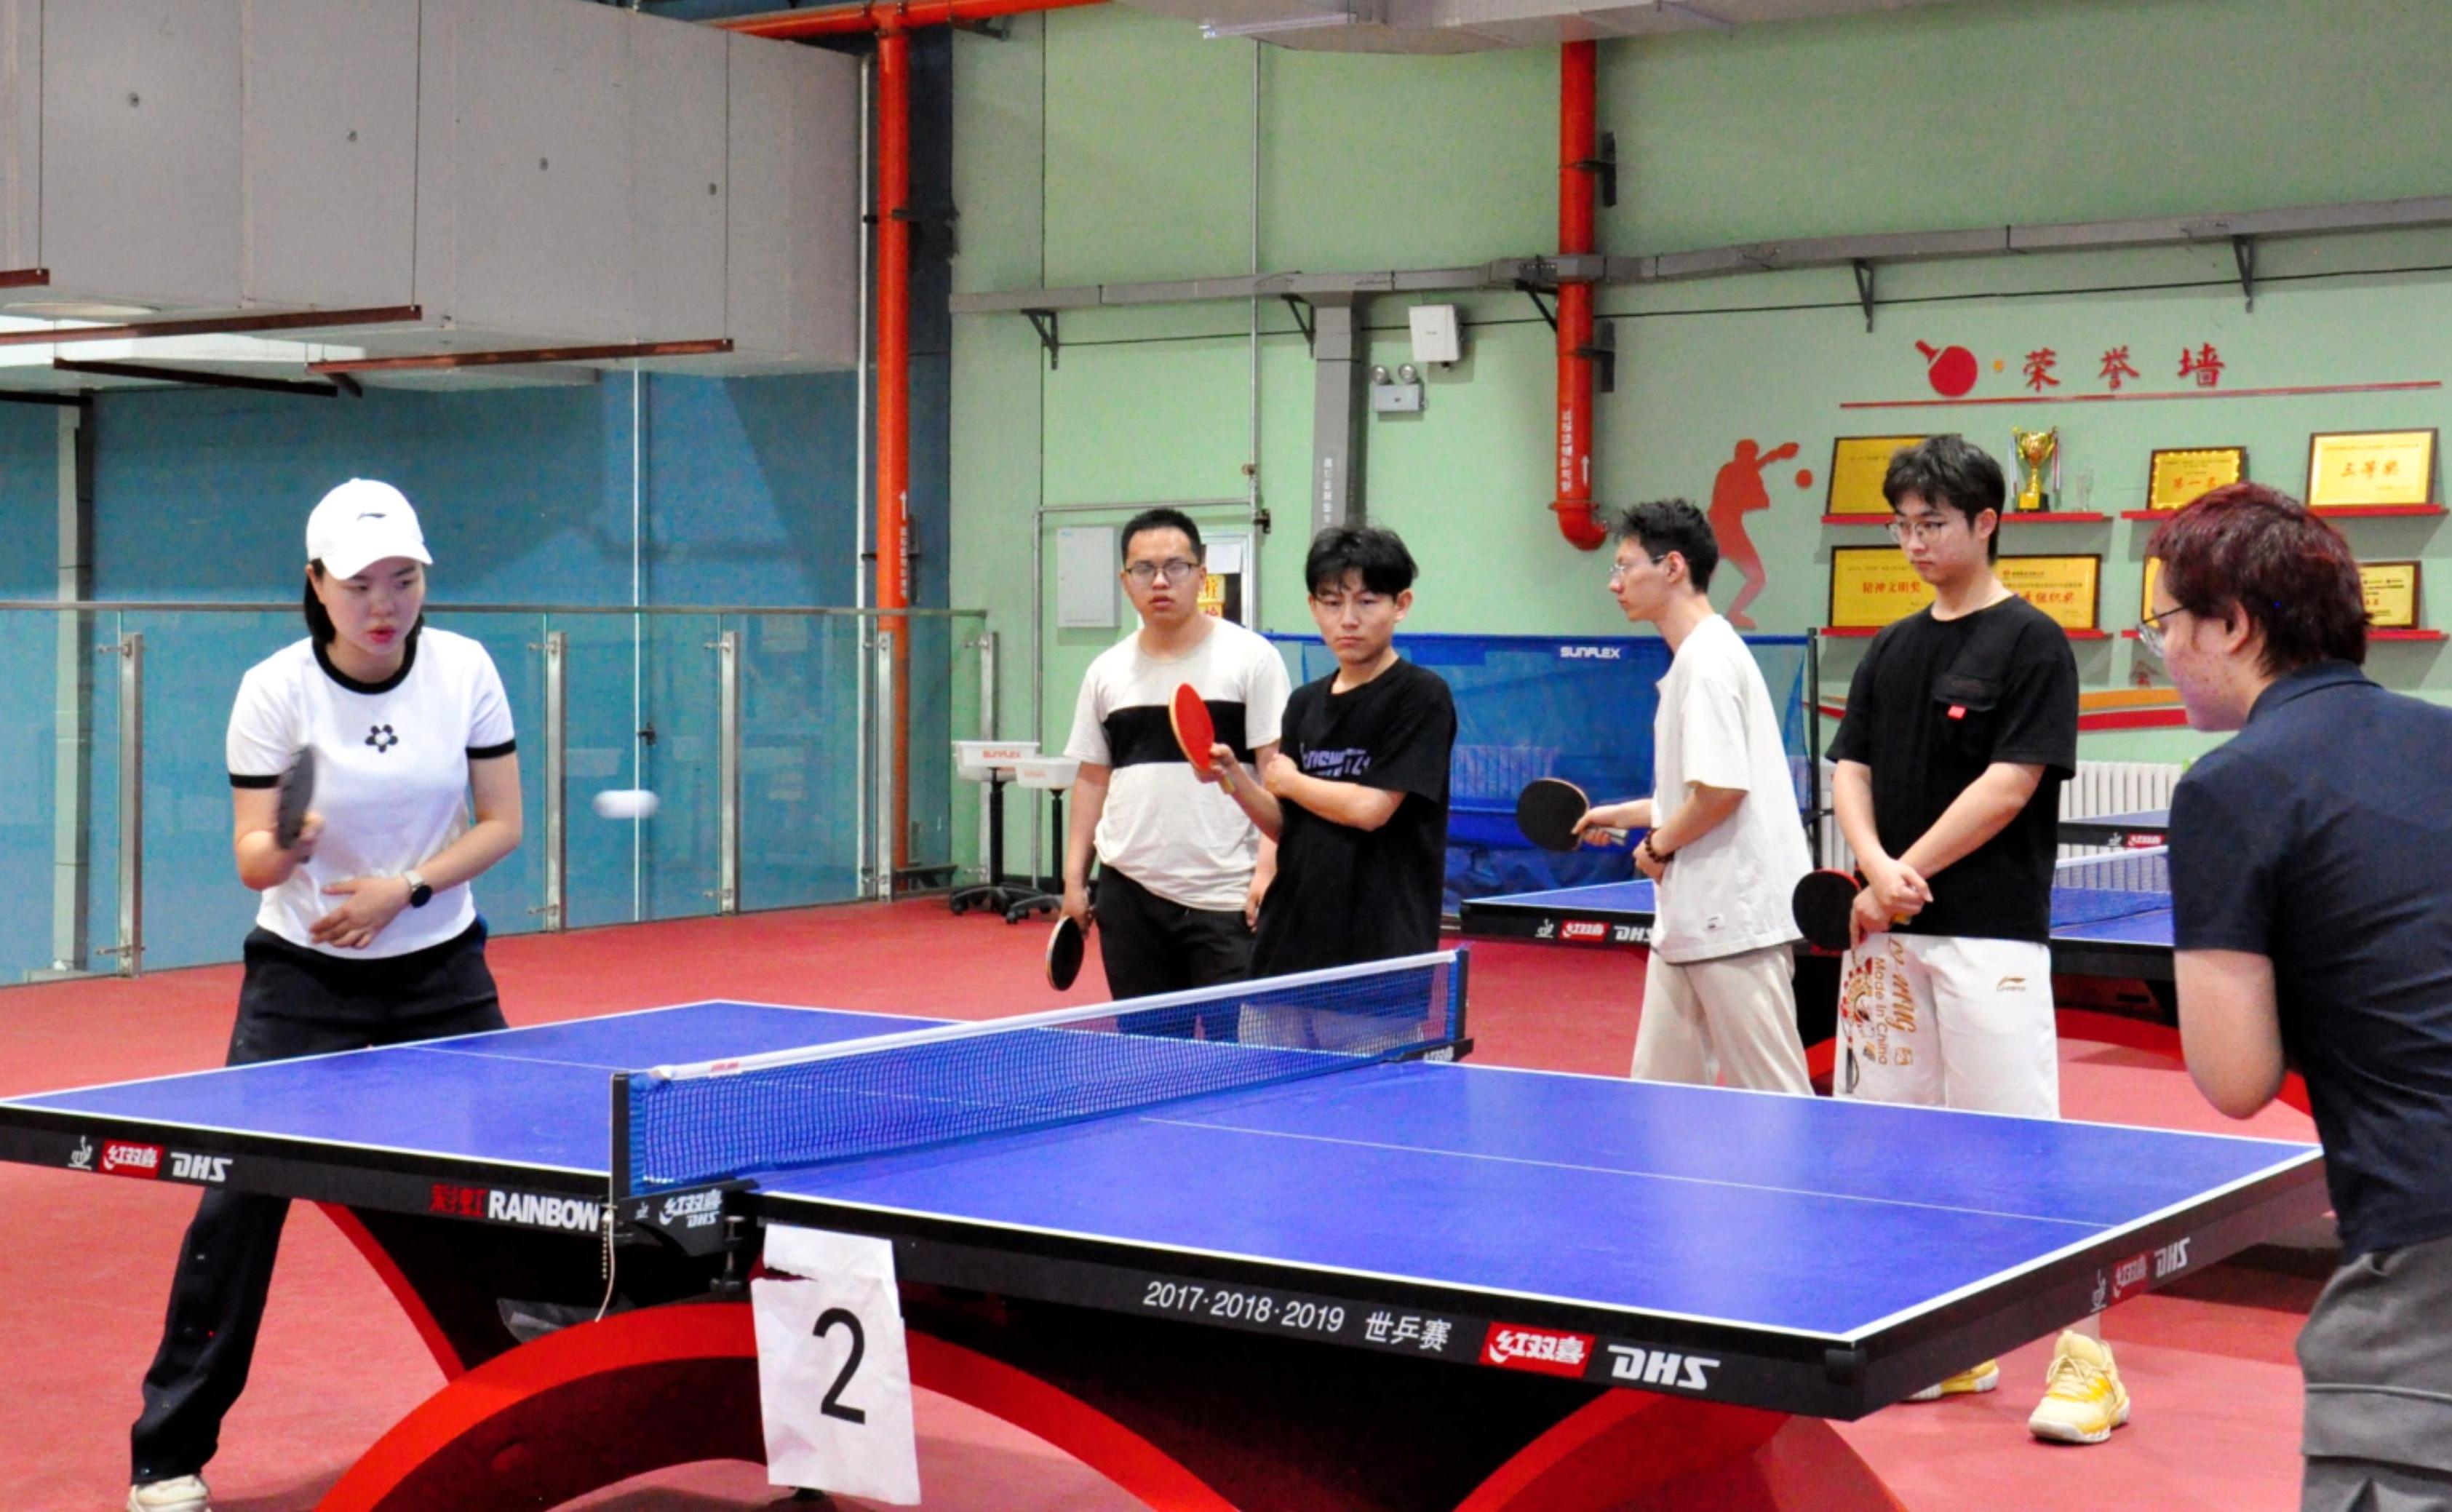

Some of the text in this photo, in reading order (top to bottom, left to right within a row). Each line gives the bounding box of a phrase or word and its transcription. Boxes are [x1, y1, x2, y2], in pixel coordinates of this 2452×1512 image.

[2022, 342, 2225, 391] 荣誉墙
[1560, 646, 1620, 659] SUNFLEX
[1874, 957, 1885, 1000] Made
[1876, 1022, 1888, 1065] China
[103, 1145, 234, 1182] 红双喜 DHS
[429, 1182, 600, 1233] 彩虹 RAINBOW
[658, 1189, 723, 1226] 红双喜
[686, 1210, 721, 1229] DHS
[2153, 1236, 2191, 1278] DHS
[1364, 1310, 1452, 1352] 世乒赛
[812, 1307, 866, 1425] 2
[1489, 1329, 1721, 1390] 红双喜 DHS
